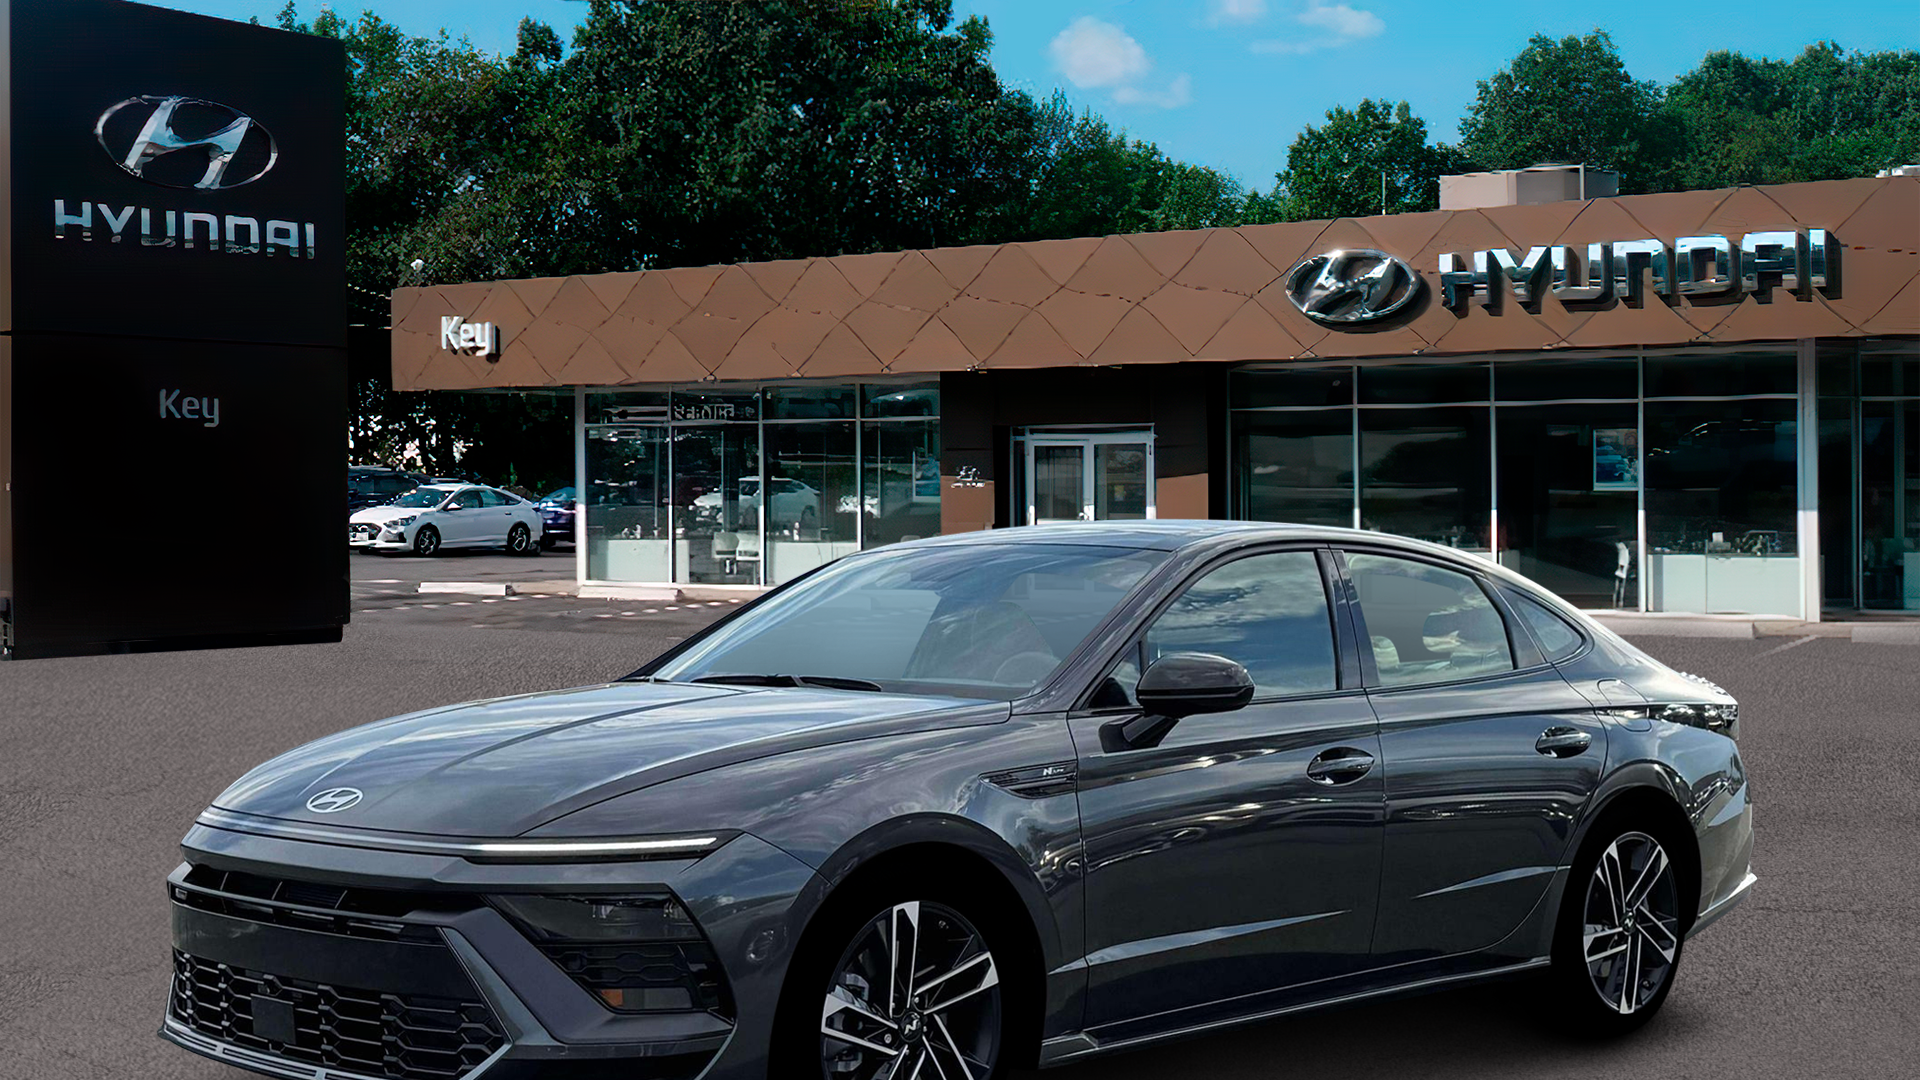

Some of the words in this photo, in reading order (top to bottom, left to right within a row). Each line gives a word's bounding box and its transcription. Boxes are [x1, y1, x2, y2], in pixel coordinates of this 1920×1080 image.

[54, 199, 315, 260] HYUNDAI
[1438, 228, 1842, 317] HYUNDAI
[441, 315, 493, 357] Key
[158, 388, 220, 428] Key
